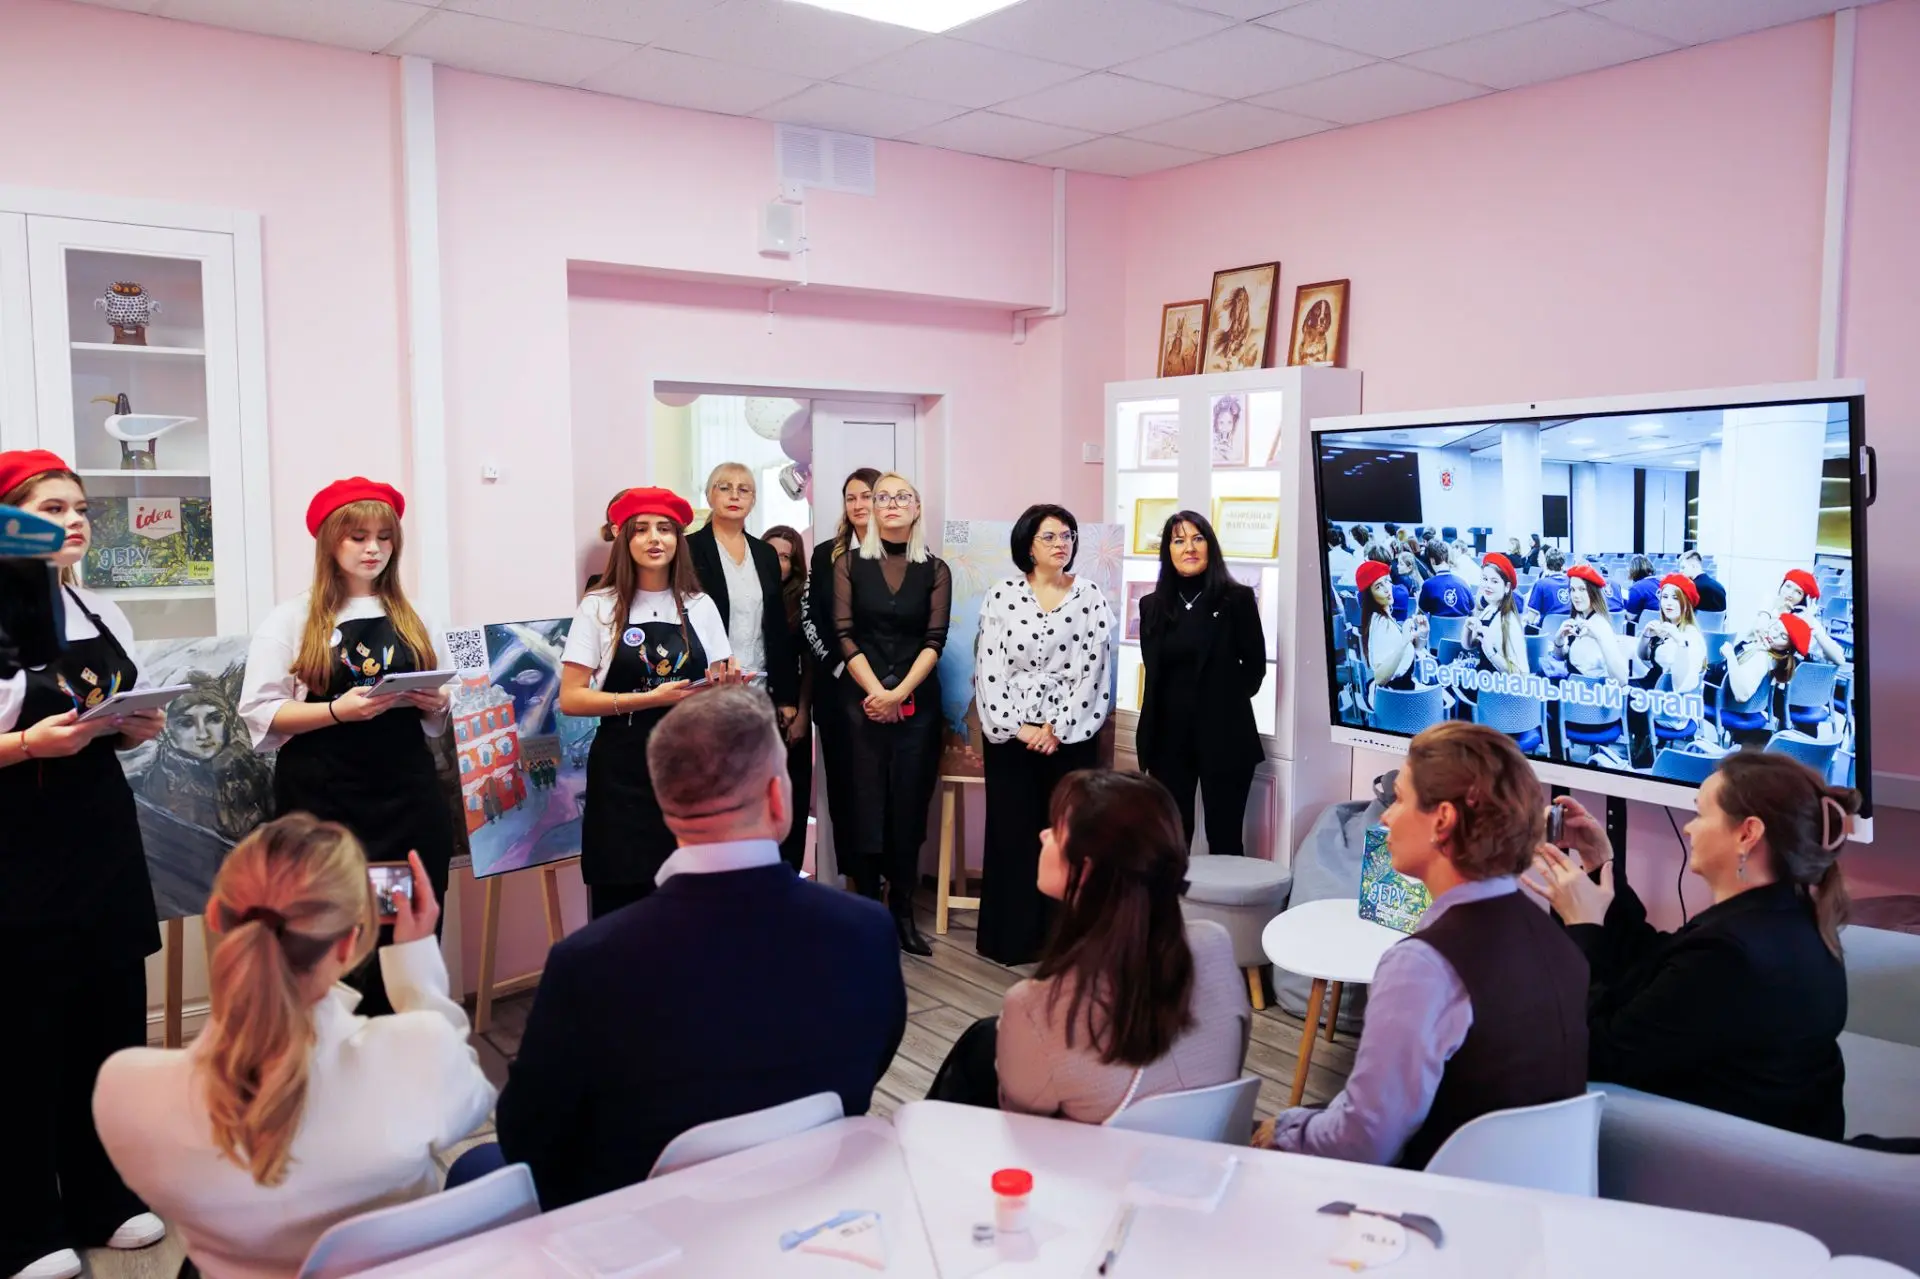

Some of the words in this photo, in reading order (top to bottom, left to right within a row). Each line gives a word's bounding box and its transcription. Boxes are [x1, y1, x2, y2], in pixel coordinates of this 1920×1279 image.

[136, 506, 173, 529] idea
[99, 546, 151, 570] ЭБРУ
[1419, 657, 1622, 710] Региональный
[1629, 685, 1704, 719] этап
[1368, 881, 1410, 906] ЭБРУ
